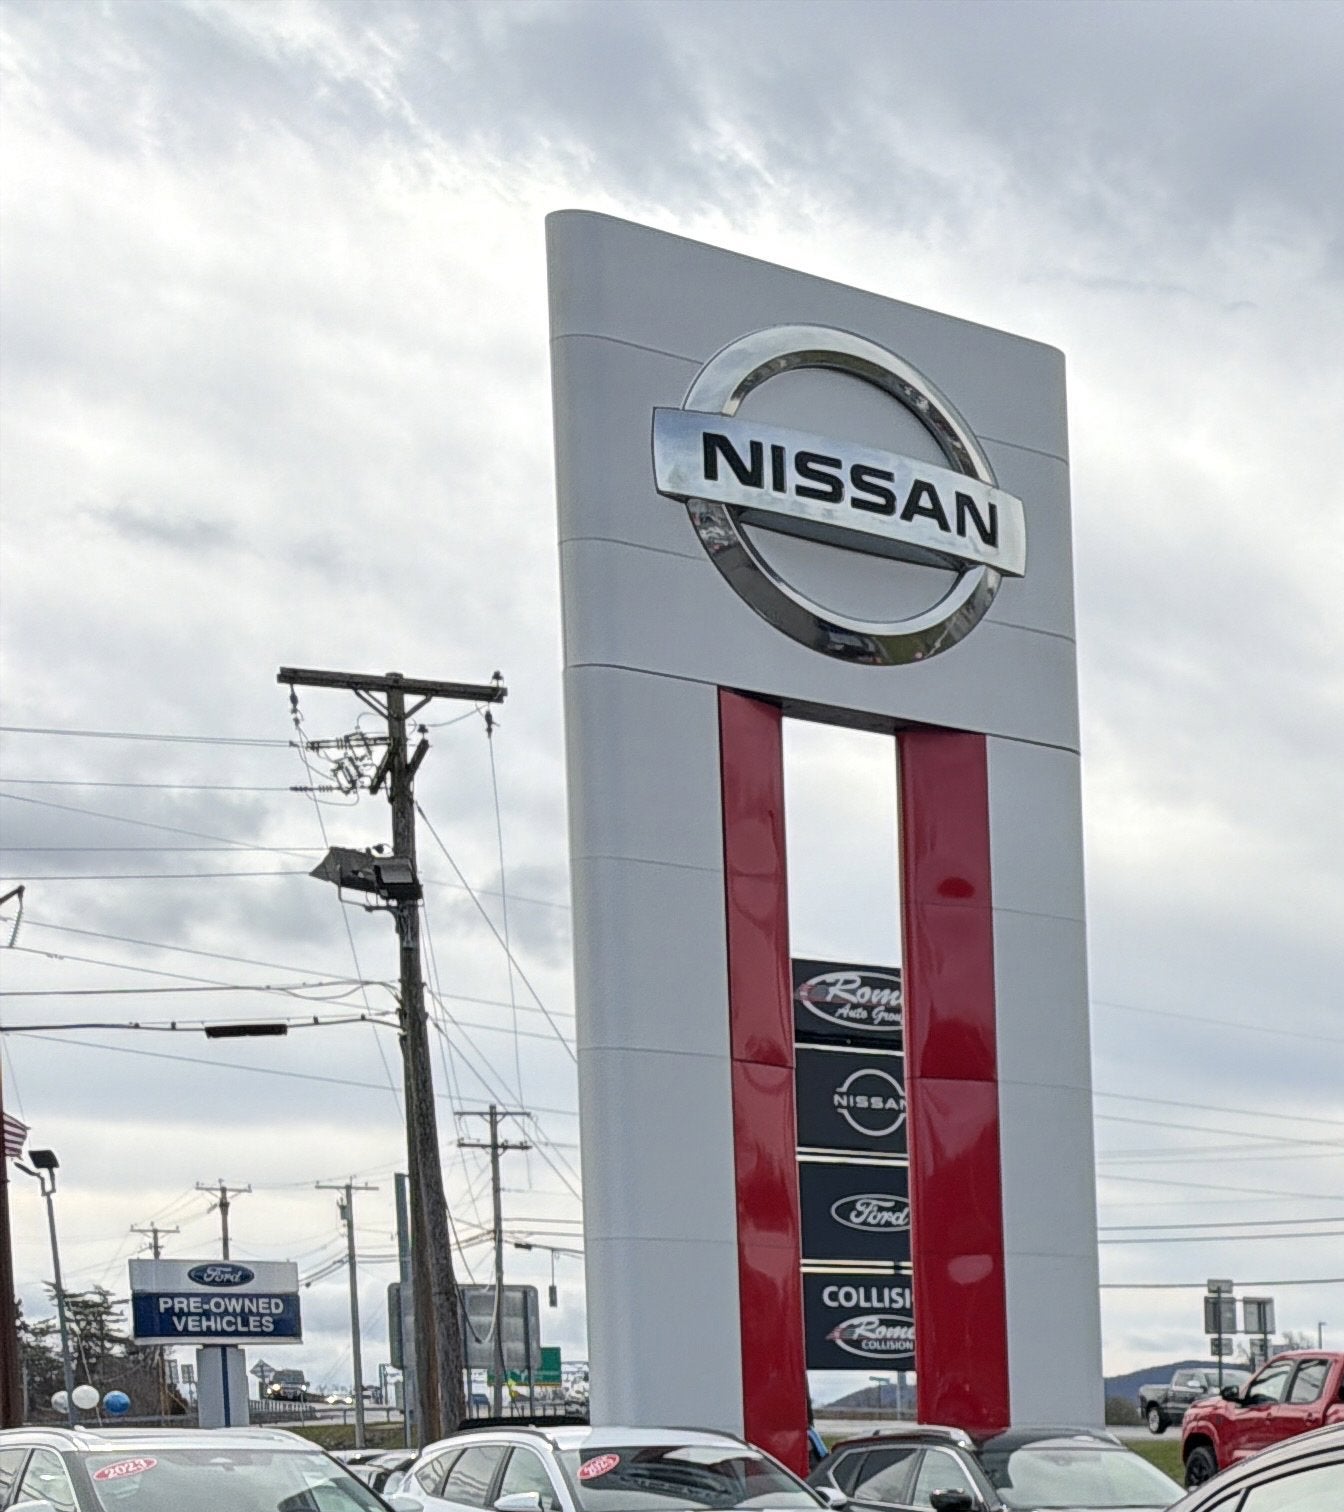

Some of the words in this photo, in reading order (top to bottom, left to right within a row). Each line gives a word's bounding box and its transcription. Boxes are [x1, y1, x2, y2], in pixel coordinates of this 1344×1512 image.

[703, 431, 998, 548] NISSAN
[834, 1002, 868, 1020] Auto
[871, 1005, 902, 1025] Grou
[850, 1199, 910, 1225] Ford
[203, 1266, 243, 1283] Ford
[158, 1297, 284, 1314] PRE-OWNED
[822, 1285, 911, 1309] COLLISI
[172, 1315, 275, 1333] VEHICLES
[861, 1339, 914, 1351] COLLISION
